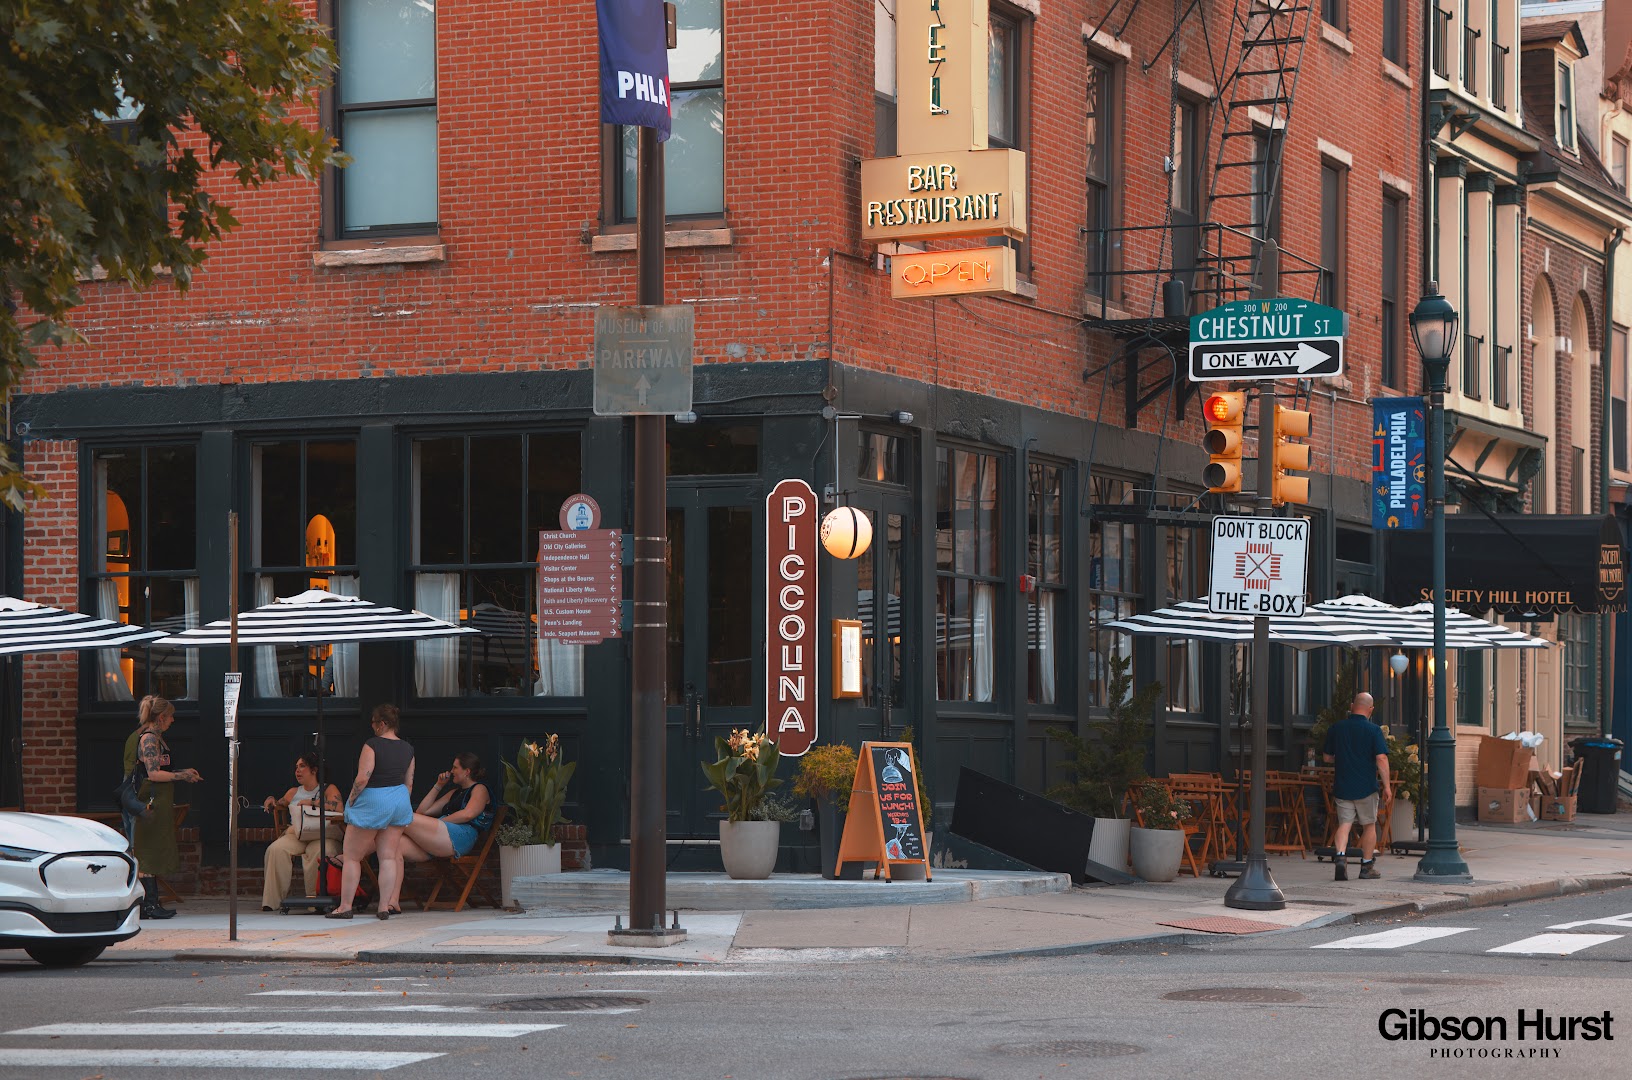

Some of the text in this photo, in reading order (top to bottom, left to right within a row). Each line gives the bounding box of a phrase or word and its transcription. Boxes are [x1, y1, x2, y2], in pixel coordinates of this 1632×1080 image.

[926, 0, 949, 116] EL
[907, 163, 959, 194] BAR
[867, 192, 1003, 229] RESTAURANT
[902, 259, 992, 287] OPEN
[1243, 302, 1288, 314] 300 W 200
[599, 317, 690, 335] MUSEUM OF ART
[1198, 313, 1330, 340] CHESTNUT ST
[600, 348, 687, 369] PARKWAY
[1208, 351, 1297, 368] ONE WAY
[1390, 411, 1407, 509] PHILADELPHIA
[1217, 521, 1303, 541] DON'T BLOCK
[553, 543, 563, 551] City
[543, 554, 579, 562] Independence
[1216, 592, 1299, 614] THE BOX
[1488, 590, 1521, 604] HILL
[1525, 590, 1574, 605] HOTEL
[881, 783, 907, 792] JOIN
[879, 793, 913, 802] US FOR
[881, 802, 915, 811] LUNCH!
